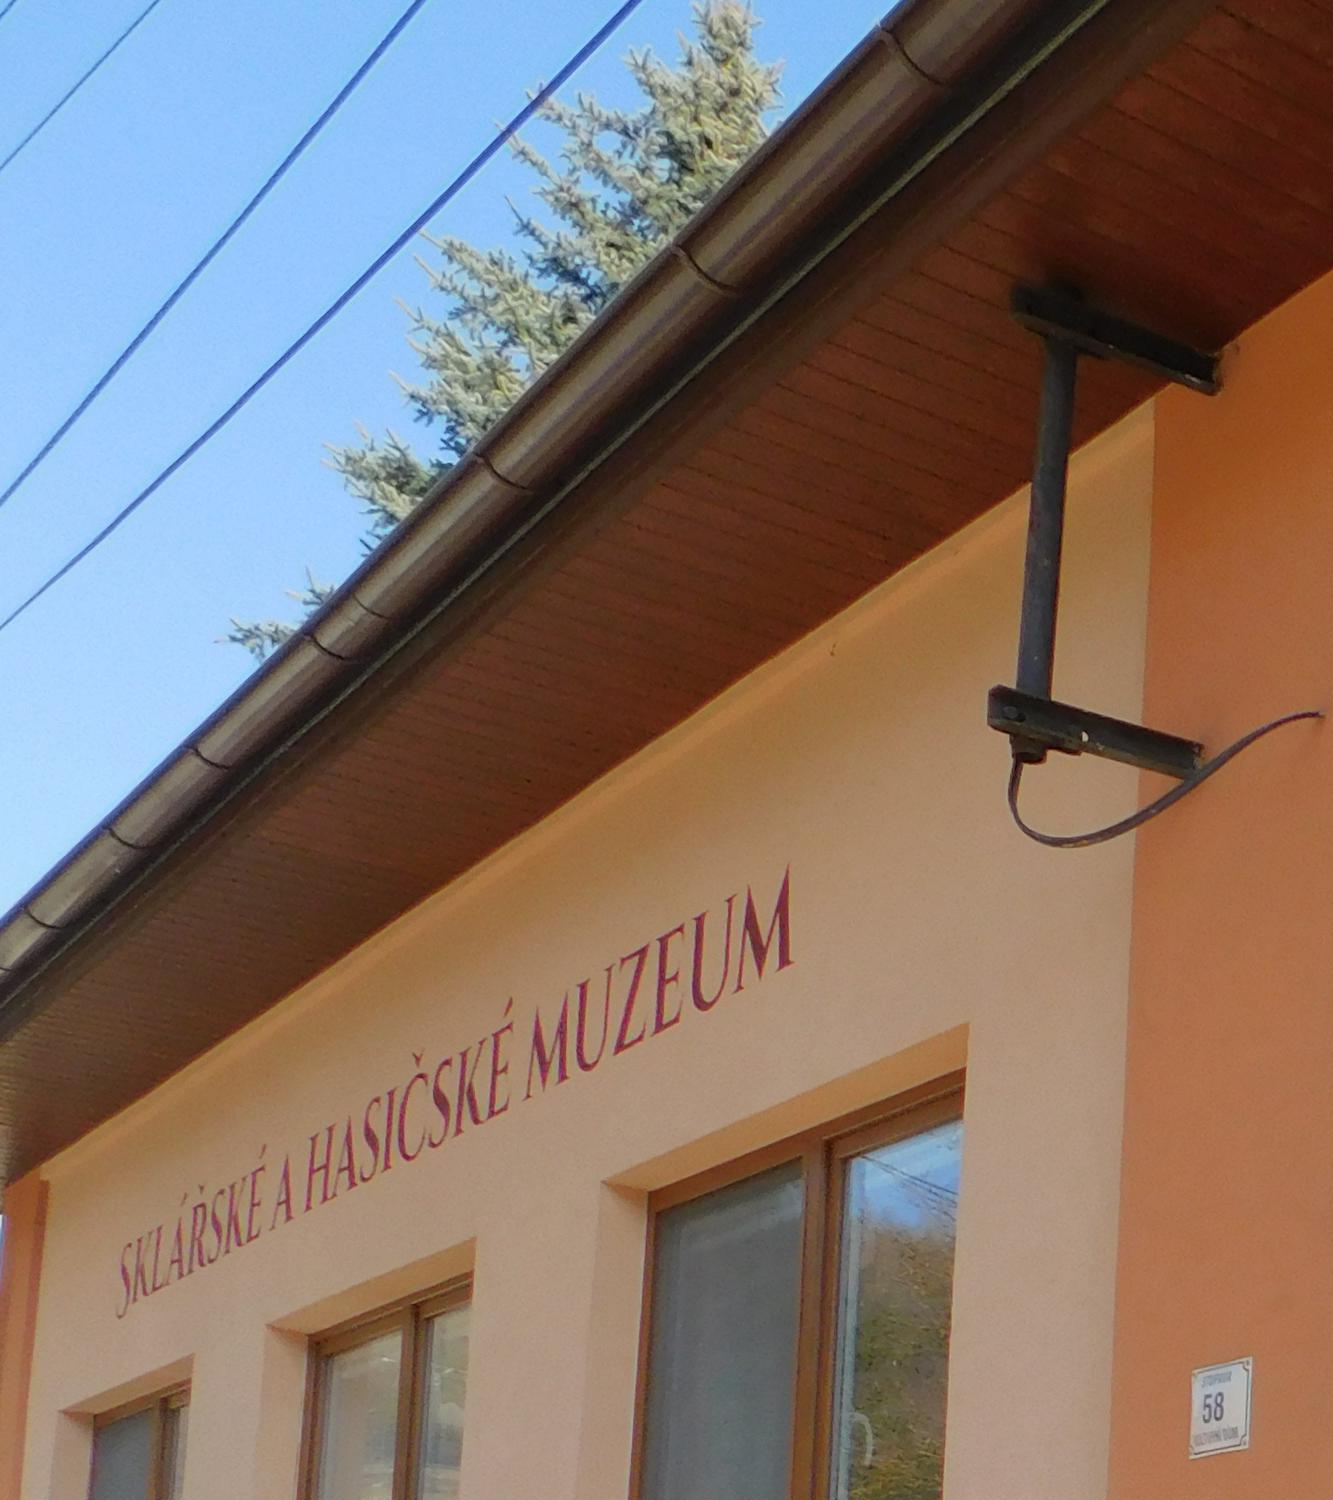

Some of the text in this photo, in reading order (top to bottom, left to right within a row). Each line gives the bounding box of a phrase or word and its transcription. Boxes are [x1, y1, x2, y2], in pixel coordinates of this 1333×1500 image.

[115, 862, 795, 1320] SKLÁŘSKÉ A HASIČSKÉ MUZEUM
[1202, 1391, 1225, 1424] 58
